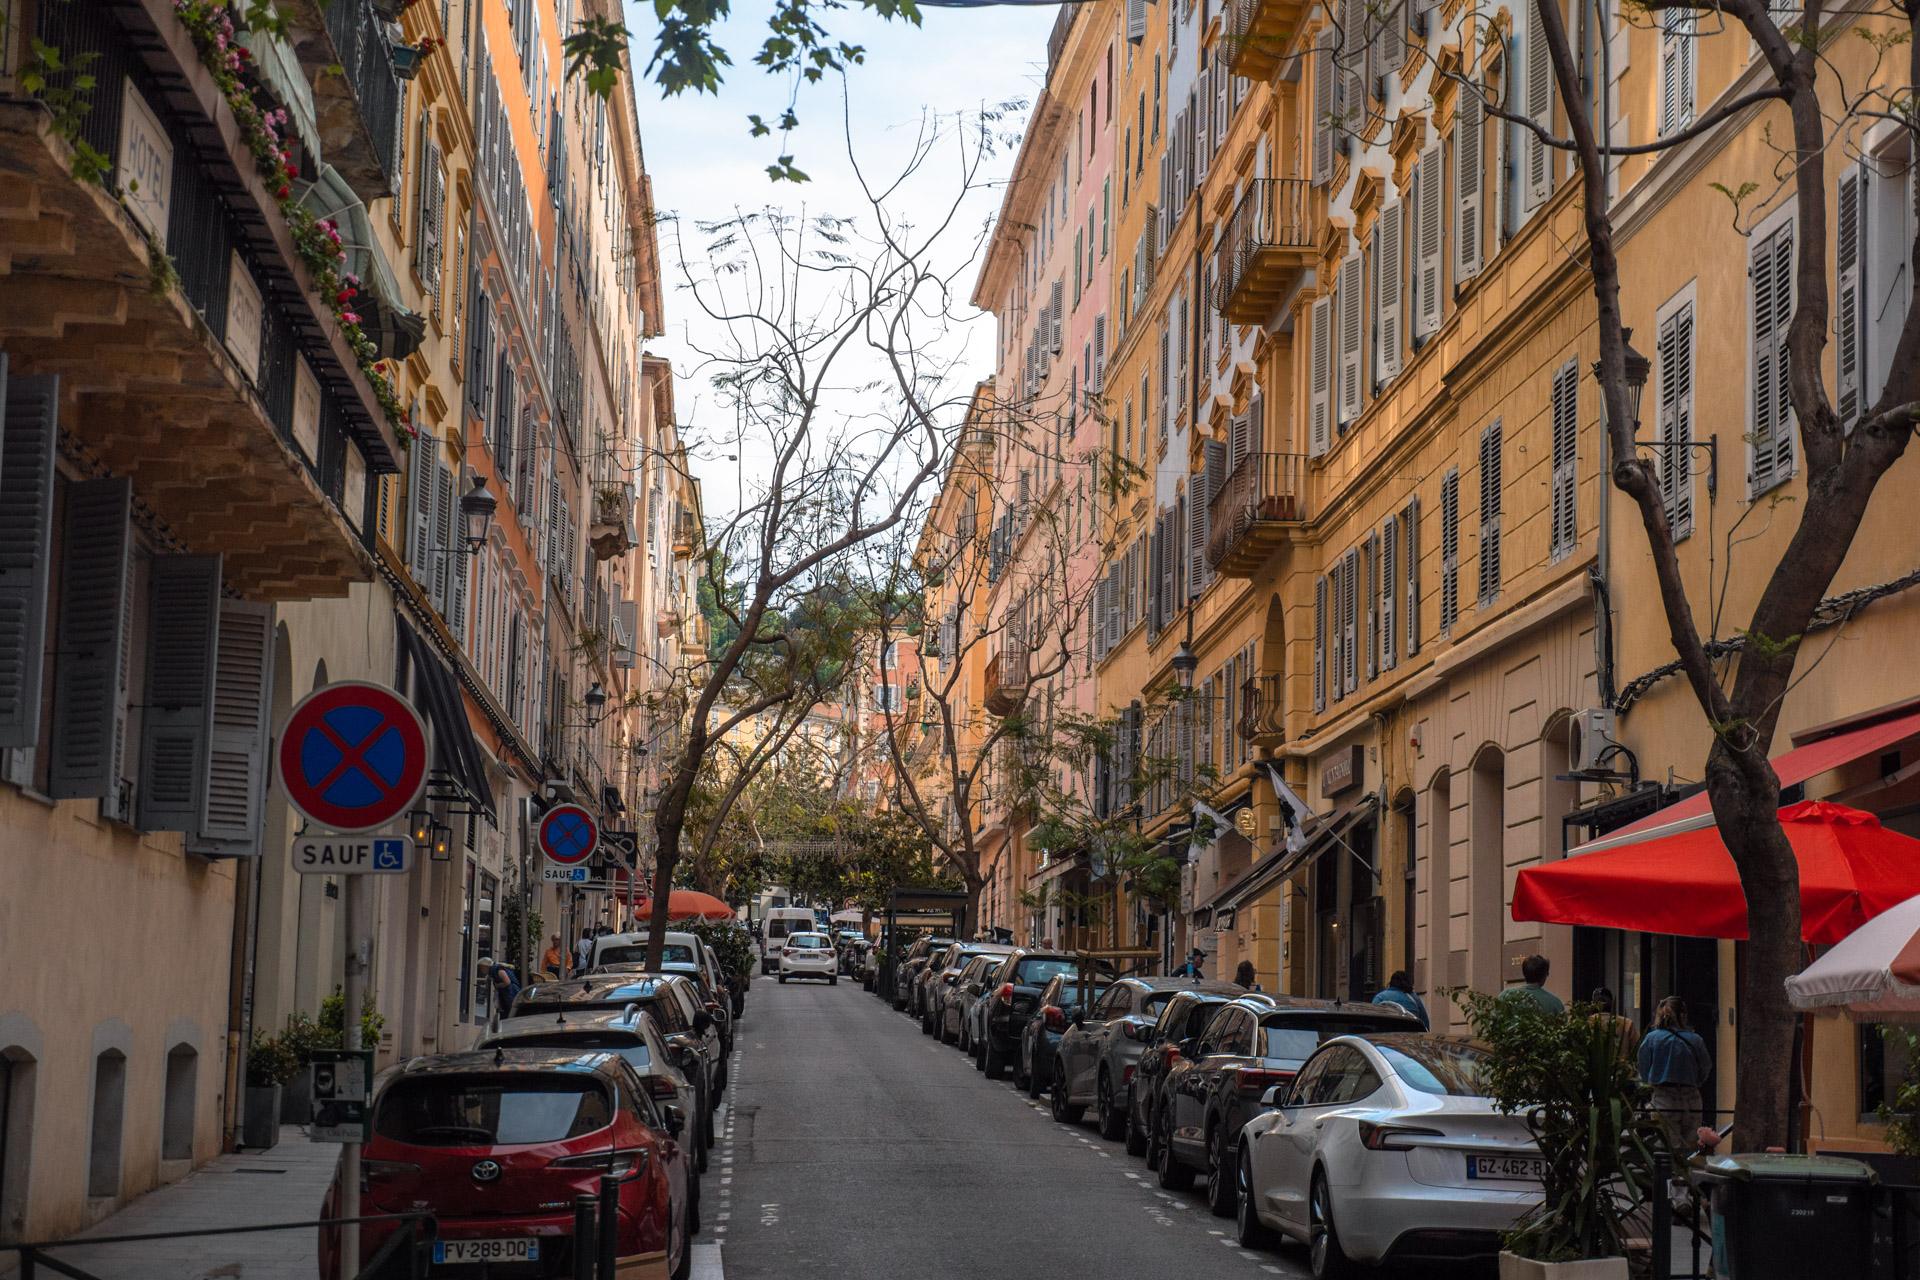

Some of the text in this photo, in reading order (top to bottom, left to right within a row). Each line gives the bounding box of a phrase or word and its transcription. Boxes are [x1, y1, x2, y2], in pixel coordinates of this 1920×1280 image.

[127, 118, 165, 210] HOTEL
[303, 844, 369, 865] SAUF
[544, 869, 572, 880] SAUF
[1478, 1158, 1546, 1177] GZ-462-B
[444, 1240, 527, 1259] FV-289-DQ
